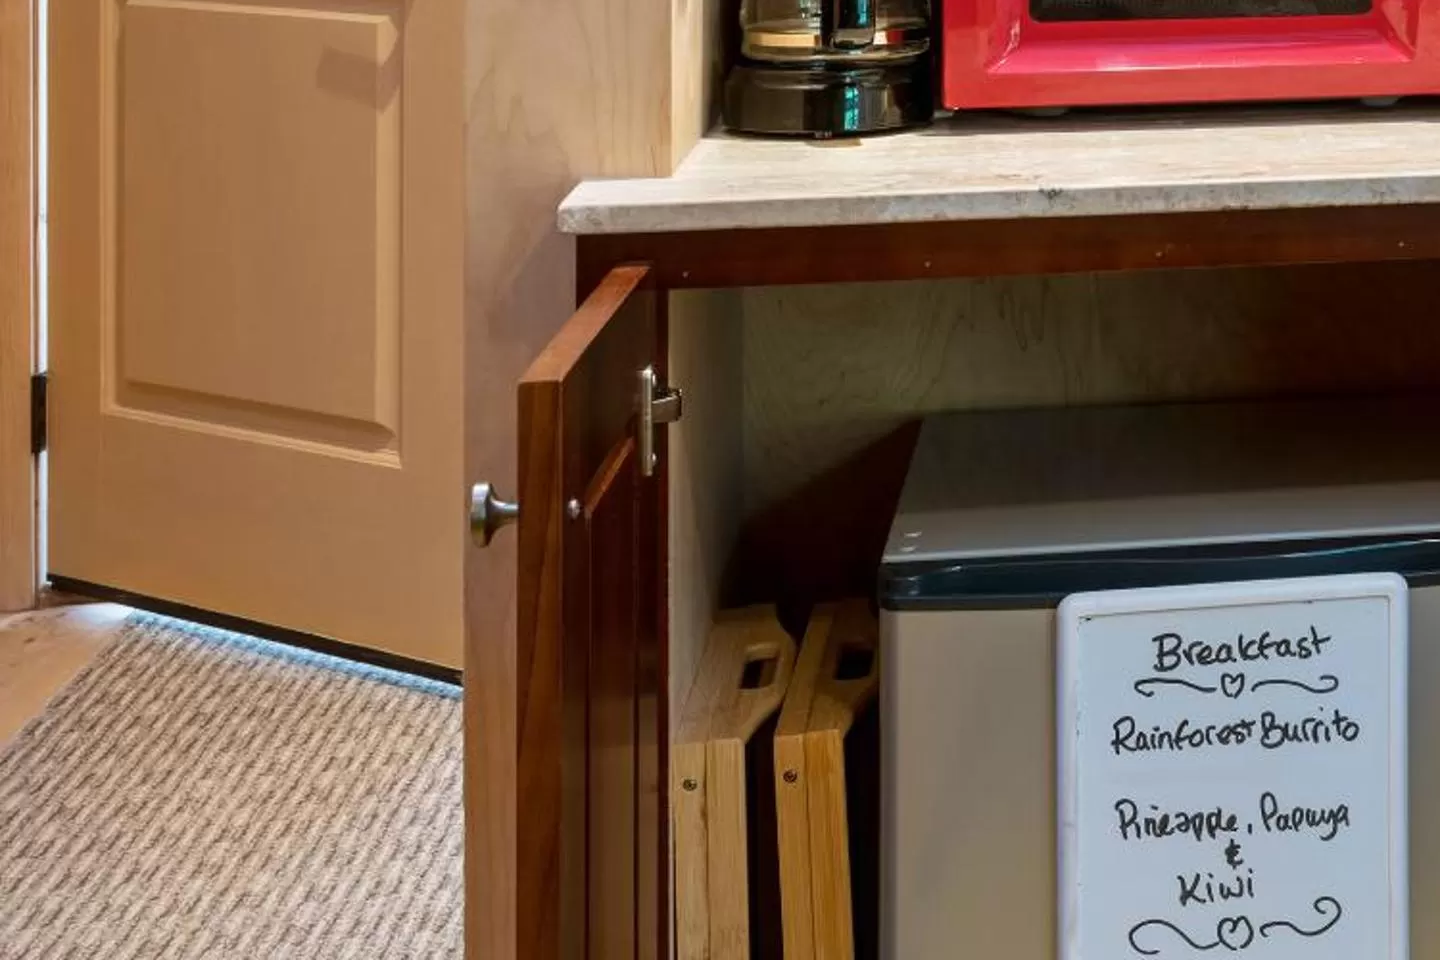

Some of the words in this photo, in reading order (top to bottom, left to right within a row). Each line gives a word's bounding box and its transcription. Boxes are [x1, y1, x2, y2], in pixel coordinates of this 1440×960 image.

[1151, 625, 1331, 672] Breakfast
[1111, 715, 1256, 755] Rainforest
[1260, 707, 1360, 749] Burrito
[1177, 868, 1255, 907] Kiwi
